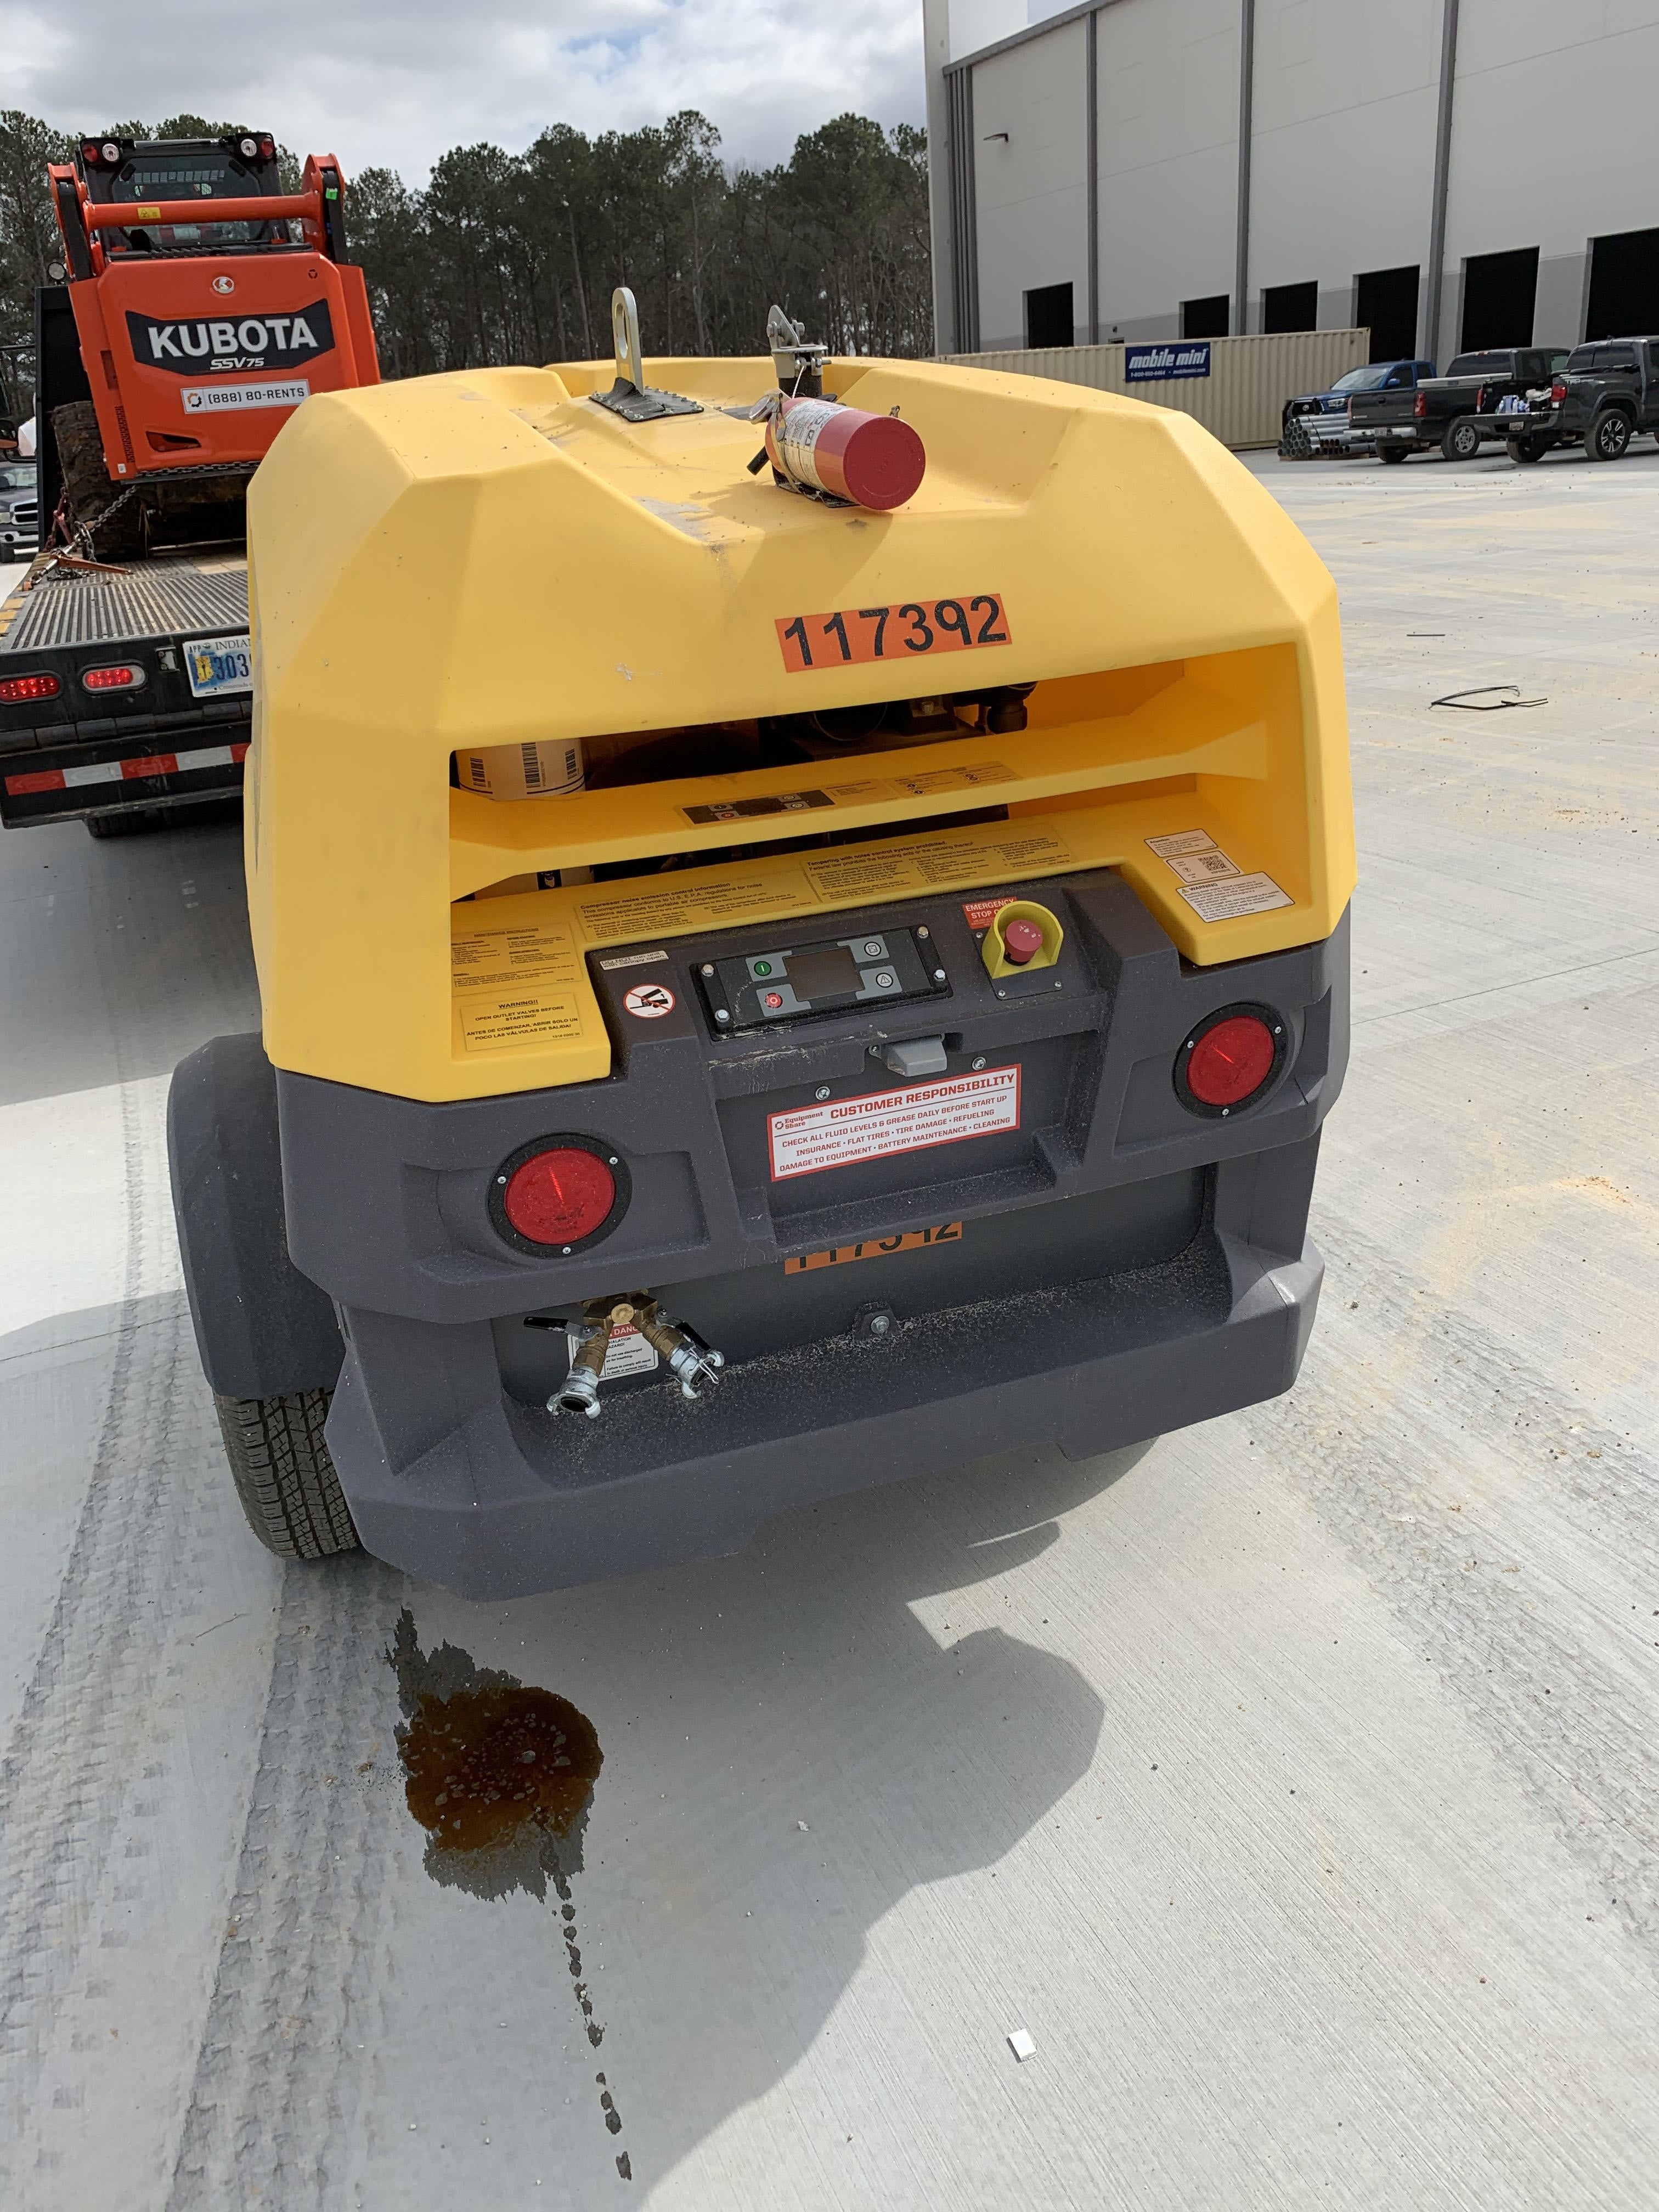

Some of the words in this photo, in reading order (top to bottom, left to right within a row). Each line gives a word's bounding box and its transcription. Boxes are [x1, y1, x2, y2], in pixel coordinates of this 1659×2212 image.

[148, 318, 319, 359] KUBOTA
[210, 357, 264, 370] SSV75
[1128, 348, 1175, 369] mobile
[1176, 348, 1207, 366] mini
[208, 391, 242, 403] (888)
[246, 387, 304, 400] 80-RENTS
[784, 596, 1006, 665] 117392
[213, 653, 252, 680] 303
[807, 858, 839, 866] Tampering
[1189, 883, 1218, 891] WARNING
[580, 901, 619, 910] Compressor
[695, 882, 730, 891] information
[597, 903, 632, 912] compressor
[704, 887, 736, 895] regulations
[966, 899, 1014, 912] EMERGENCY
[971, 910, 992, 919] STOP
[498, 1000, 538, 1008] WARNING!!
[496, 1023, 532, 1032] COMENZAR,
[831, 1096, 902, 1119] CUSTOMER
[906, 1074, 1015, 1104] RESPONSIBILITY
[782, 1137, 808, 1148] CHECK
[810, 1133, 823, 1142] ALL
[825, 1128, 848, 1138] FLUID
[850, 1122, 877, 1133] LEVELS
[886, 1114, 916, 1125] GREASE
[918, 1108, 940, 1119] DAILY
[941, 1103, 969, 1114] BEFORE
[972, 1097, 995, 1108] START
[785, 1111, 823, 1124] Equipment
[785, 1121, 806, 1130] Share
[796, 1141, 842, 1156] INSURANCE
[848, 1136, 865, 1145] FLAT
[866, 1131, 890, 1141] TIRES
[896, 1126, 913, 1135] TIRE
[916, 1119, 947, 1130] DAMAGE
[953, 1109, 995, 1122] REFUELING
[780, 1159, 812, 1172] DAMAGE
[826, 1146, 872, 1161] EQUIPMENT
[878, 1137, 911, 1150] BATTERY
[913, 1126, 967, 1142] MAINTENANCE
[973, 1117, 1011, 1130] CLEANING
[614, 1326, 637, 1335] DANG
